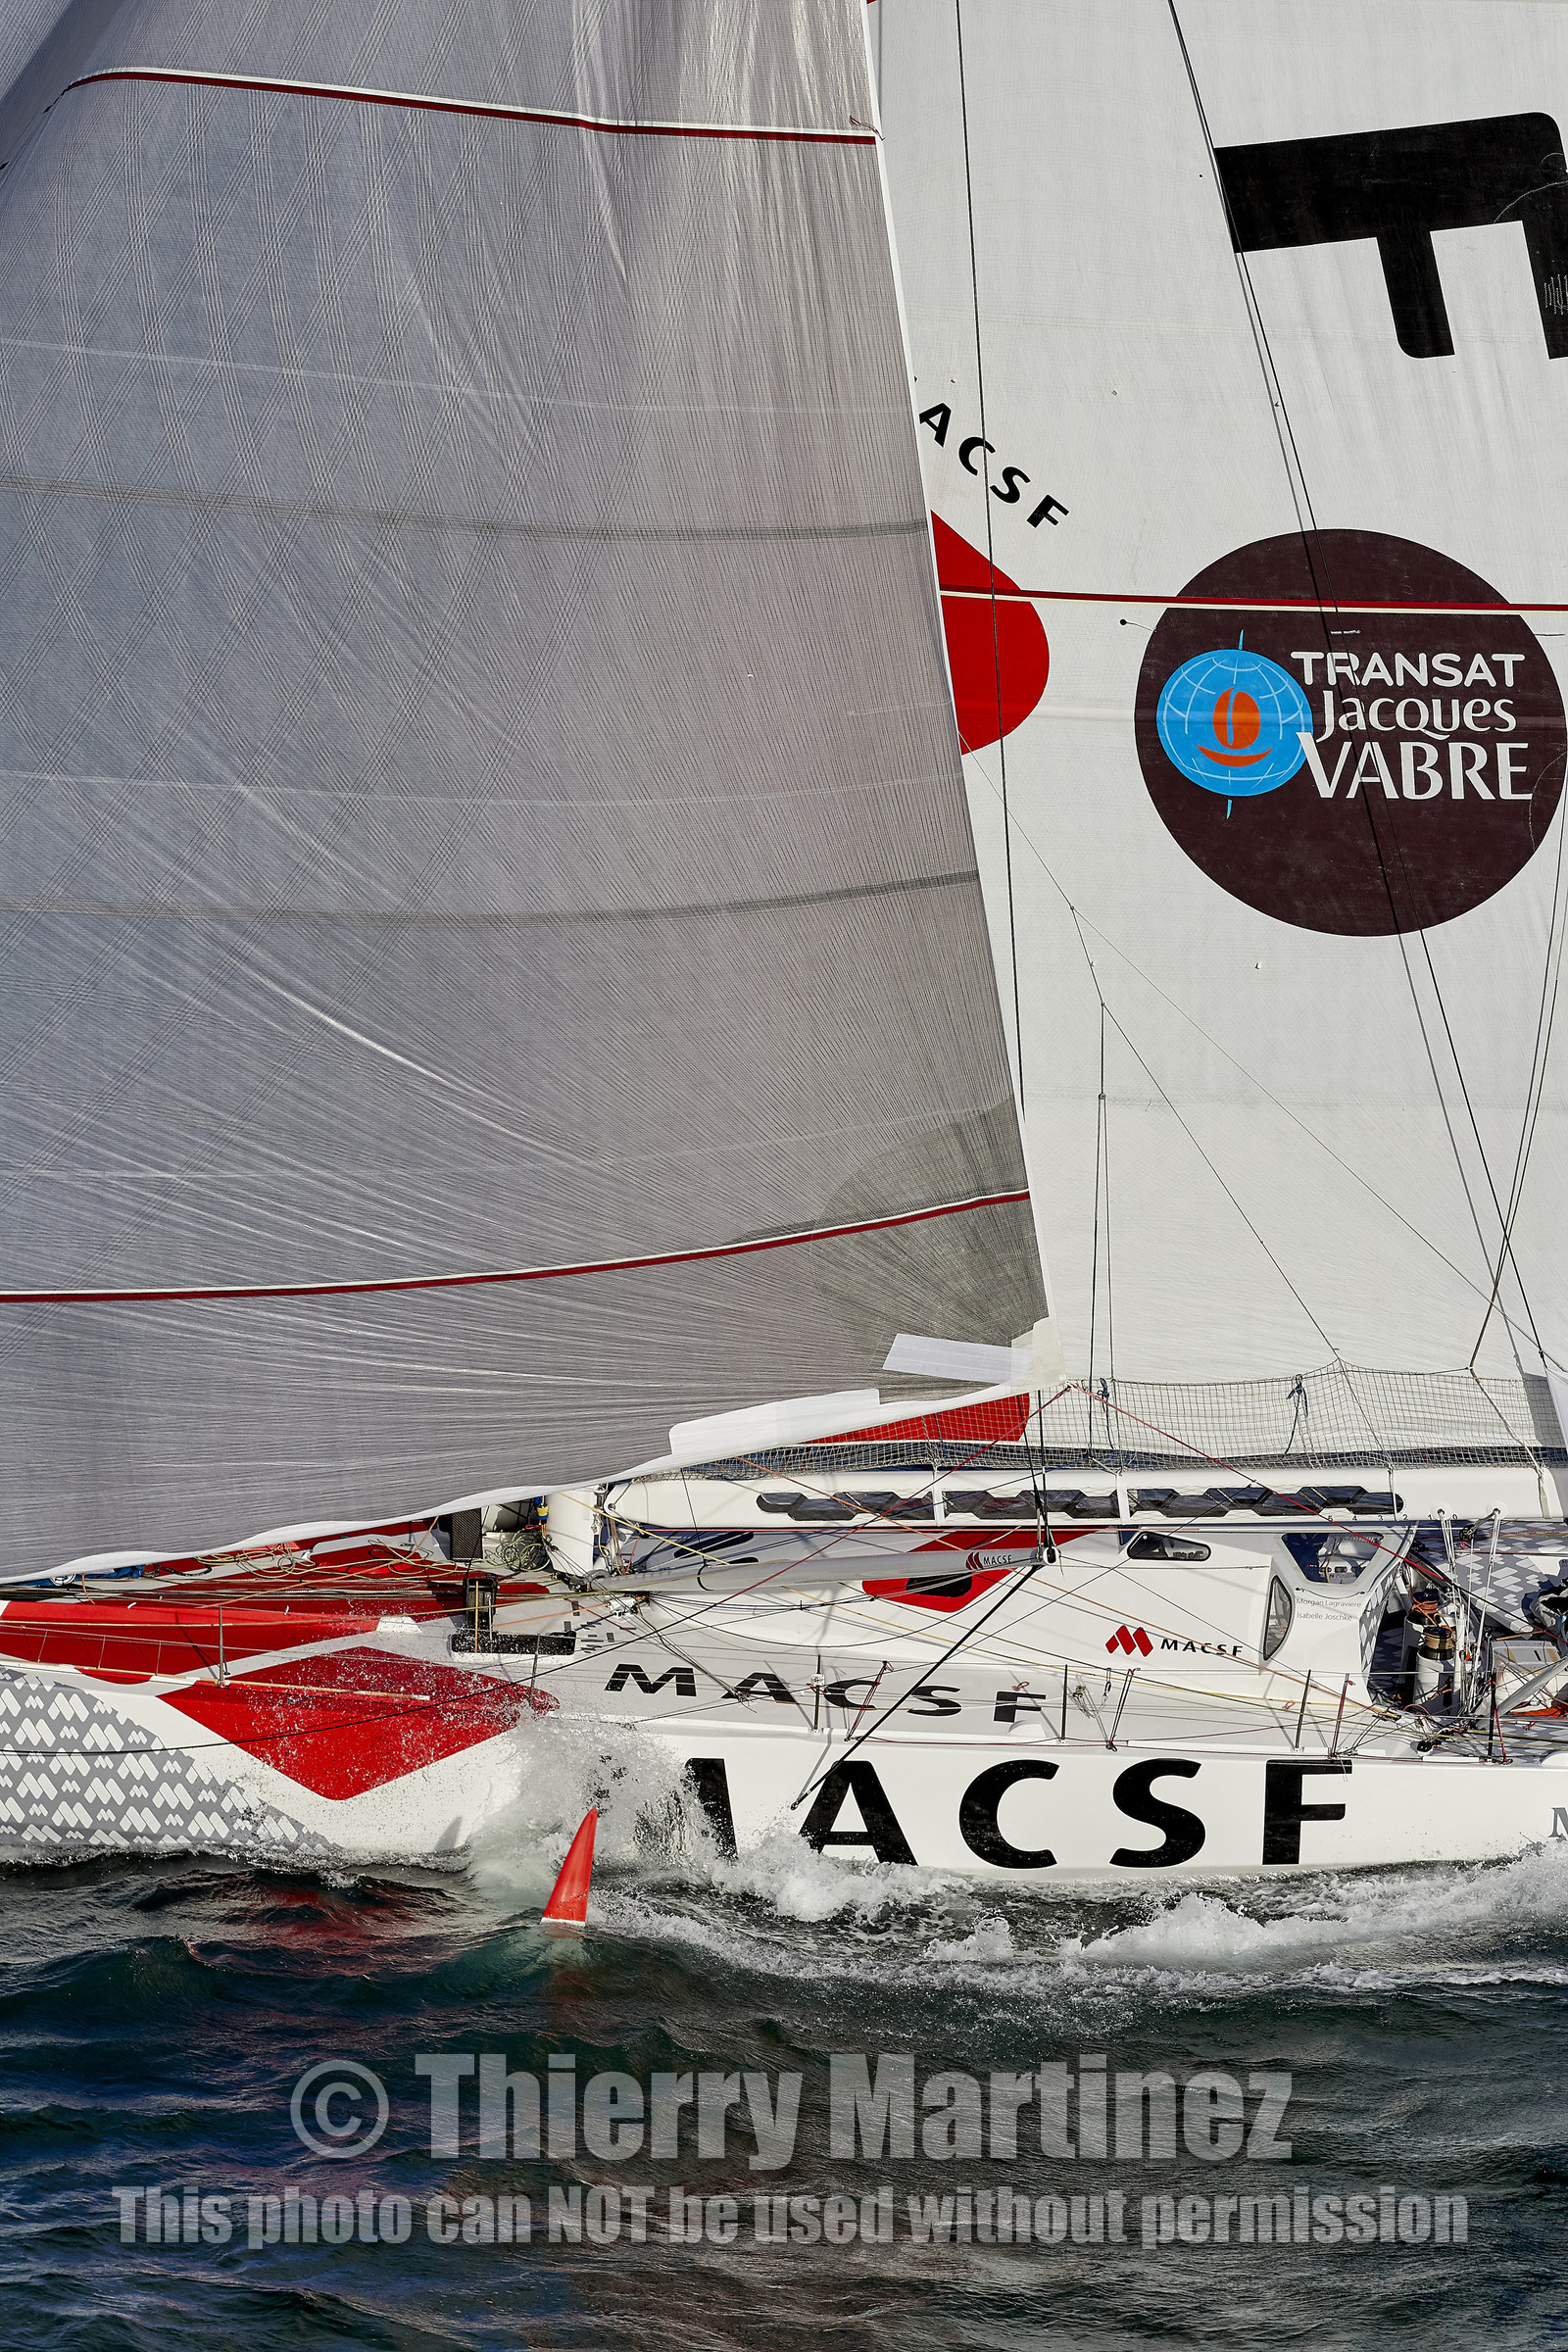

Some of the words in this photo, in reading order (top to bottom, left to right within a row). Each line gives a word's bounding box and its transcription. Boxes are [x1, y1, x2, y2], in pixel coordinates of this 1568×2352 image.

[918, 403, 1069, 528] ACSF
[1291, 651, 1526, 687] TRANSAT
[1316, 690, 1517, 743] Jacques
[1296, 732, 1534, 800] VABRE
[983, 1554, 1012, 1566] MACSF
[1296, 1598, 1324, 1607] Morgan
[1325, 1613, 1352, 1622] Joschke
[1160, 1638, 1244, 1657] MACSF
[604, 1663, 1047, 1723] MACSF
